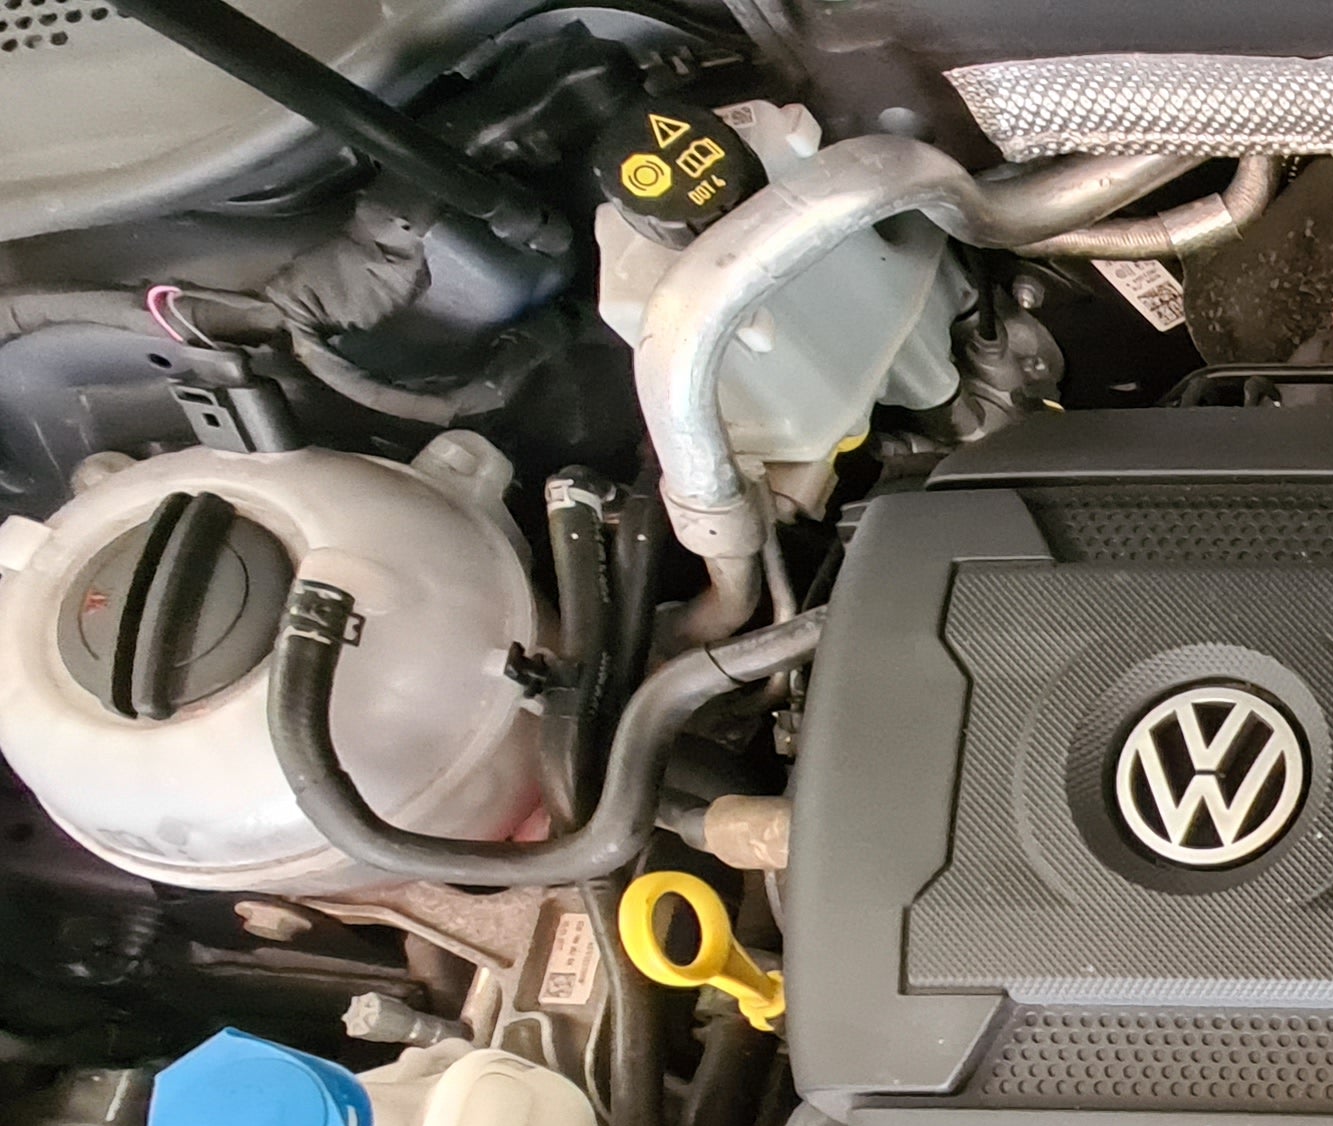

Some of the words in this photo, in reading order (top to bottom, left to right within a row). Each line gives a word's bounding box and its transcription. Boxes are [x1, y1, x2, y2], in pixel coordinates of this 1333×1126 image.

[687, 180, 716, 206] DOT
[711, 174, 727, 187] 4
[1116, 687, 1303, 864] VW
